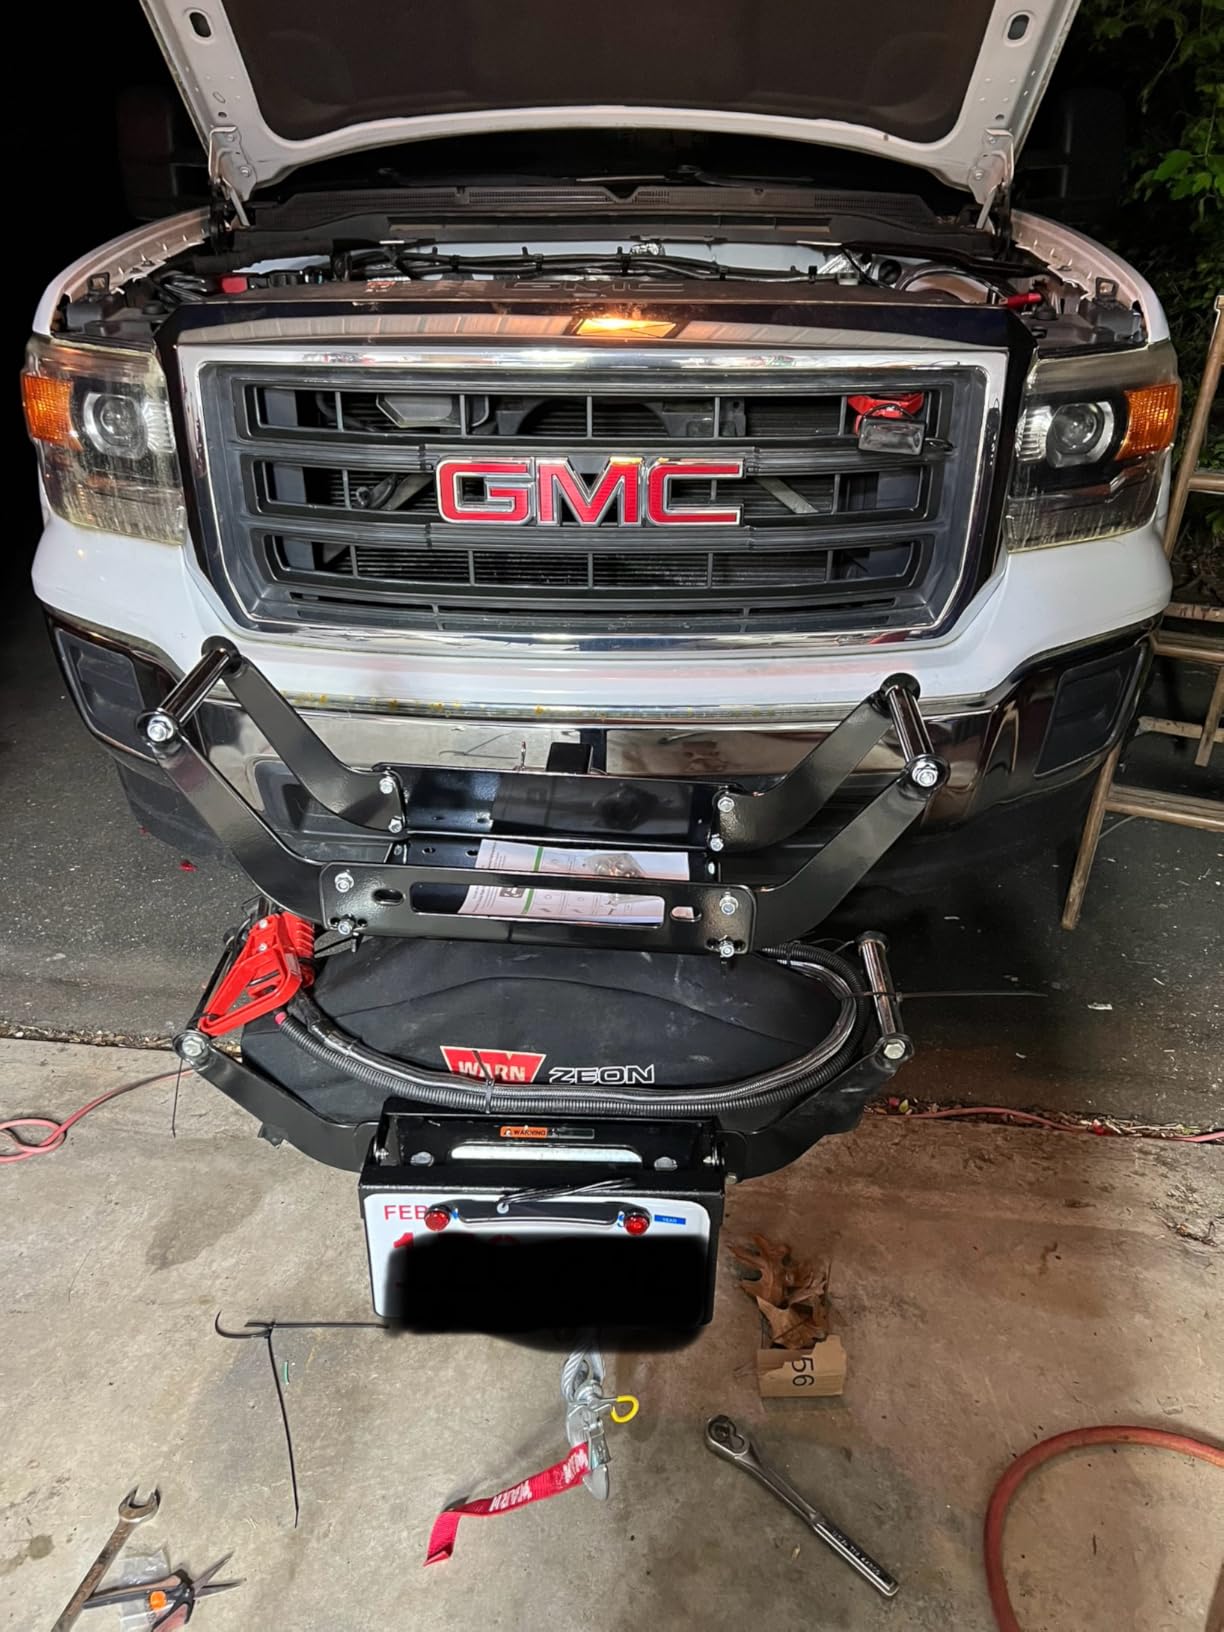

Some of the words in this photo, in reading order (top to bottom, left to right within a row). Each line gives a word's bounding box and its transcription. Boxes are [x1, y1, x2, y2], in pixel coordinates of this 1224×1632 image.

[436, 456, 745, 527] GMC
[458, 1061, 526, 1081] WARN
[549, 1064, 655, 1084] ZEON
[384, 1205, 429, 1220] FEB
[791, 1357, 815, 1387] 56
[489, 1480, 533, 1513] WARN
